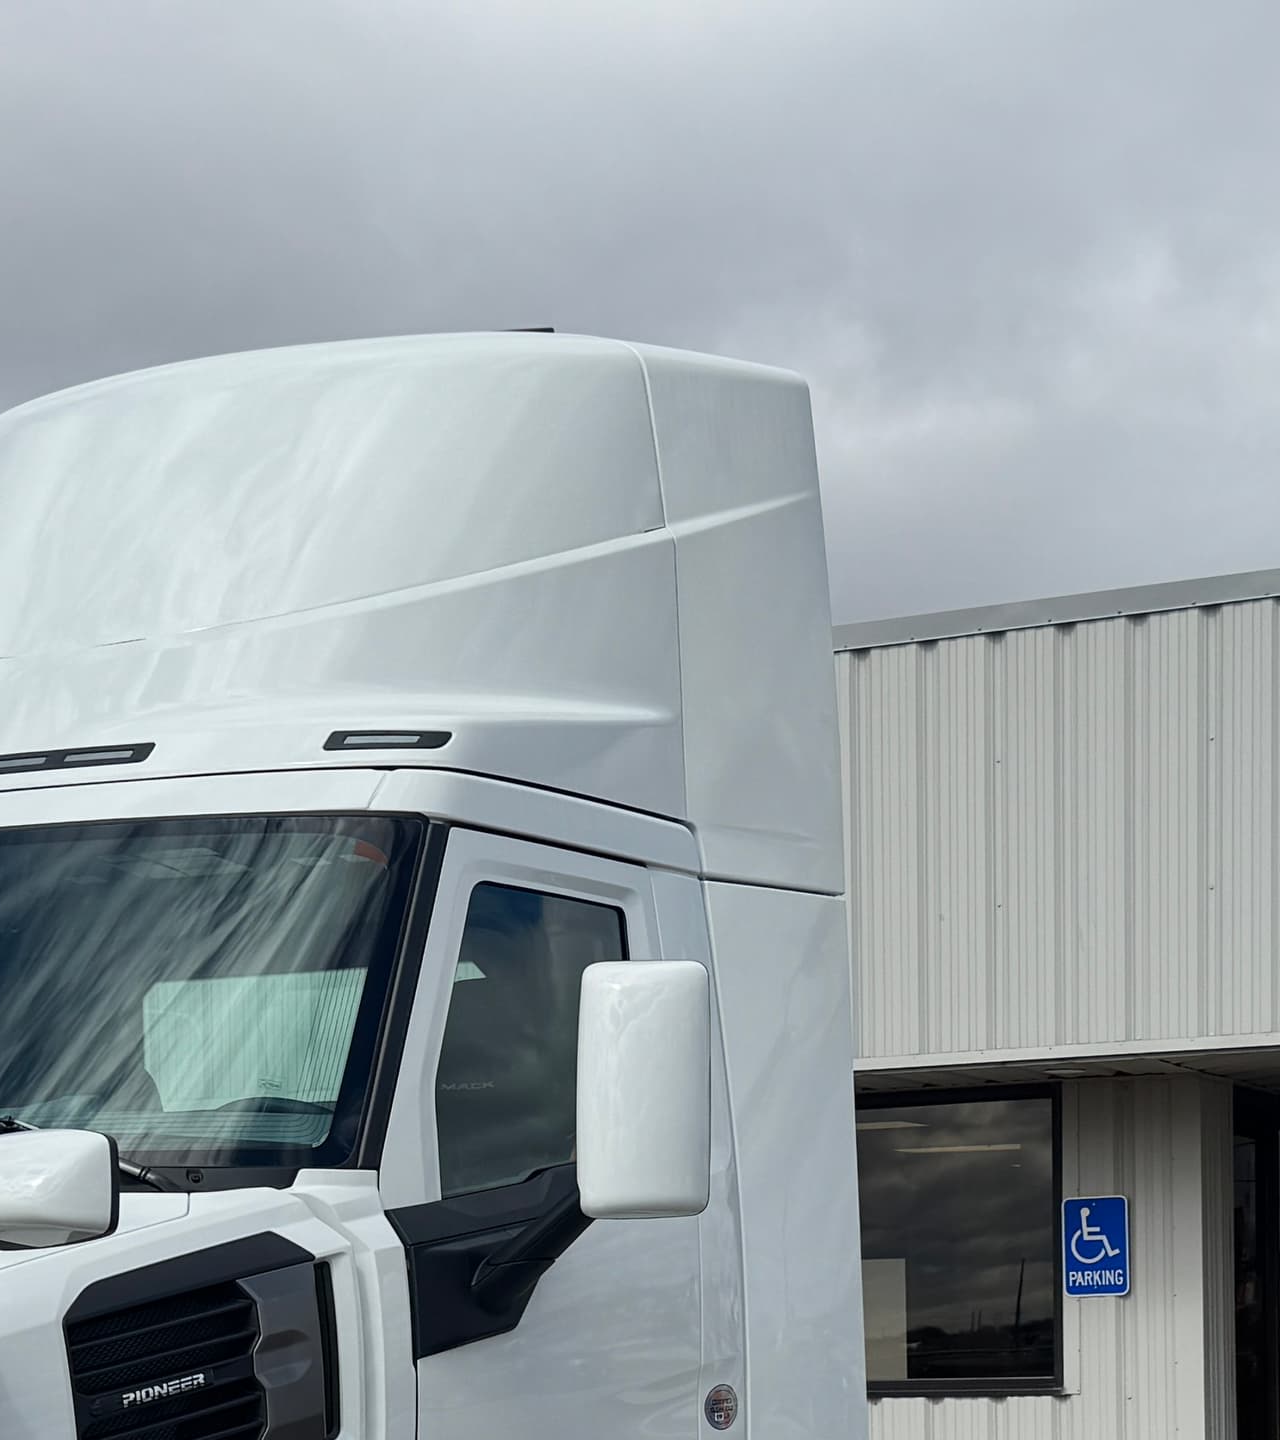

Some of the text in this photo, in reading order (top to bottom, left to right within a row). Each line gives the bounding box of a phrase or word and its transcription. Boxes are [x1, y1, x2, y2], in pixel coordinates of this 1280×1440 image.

[441, 1080, 495, 1090] MACK
[1069, 1269, 1124, 1287] PARKING
[122, 1373, 205, 1408] PIONEER
